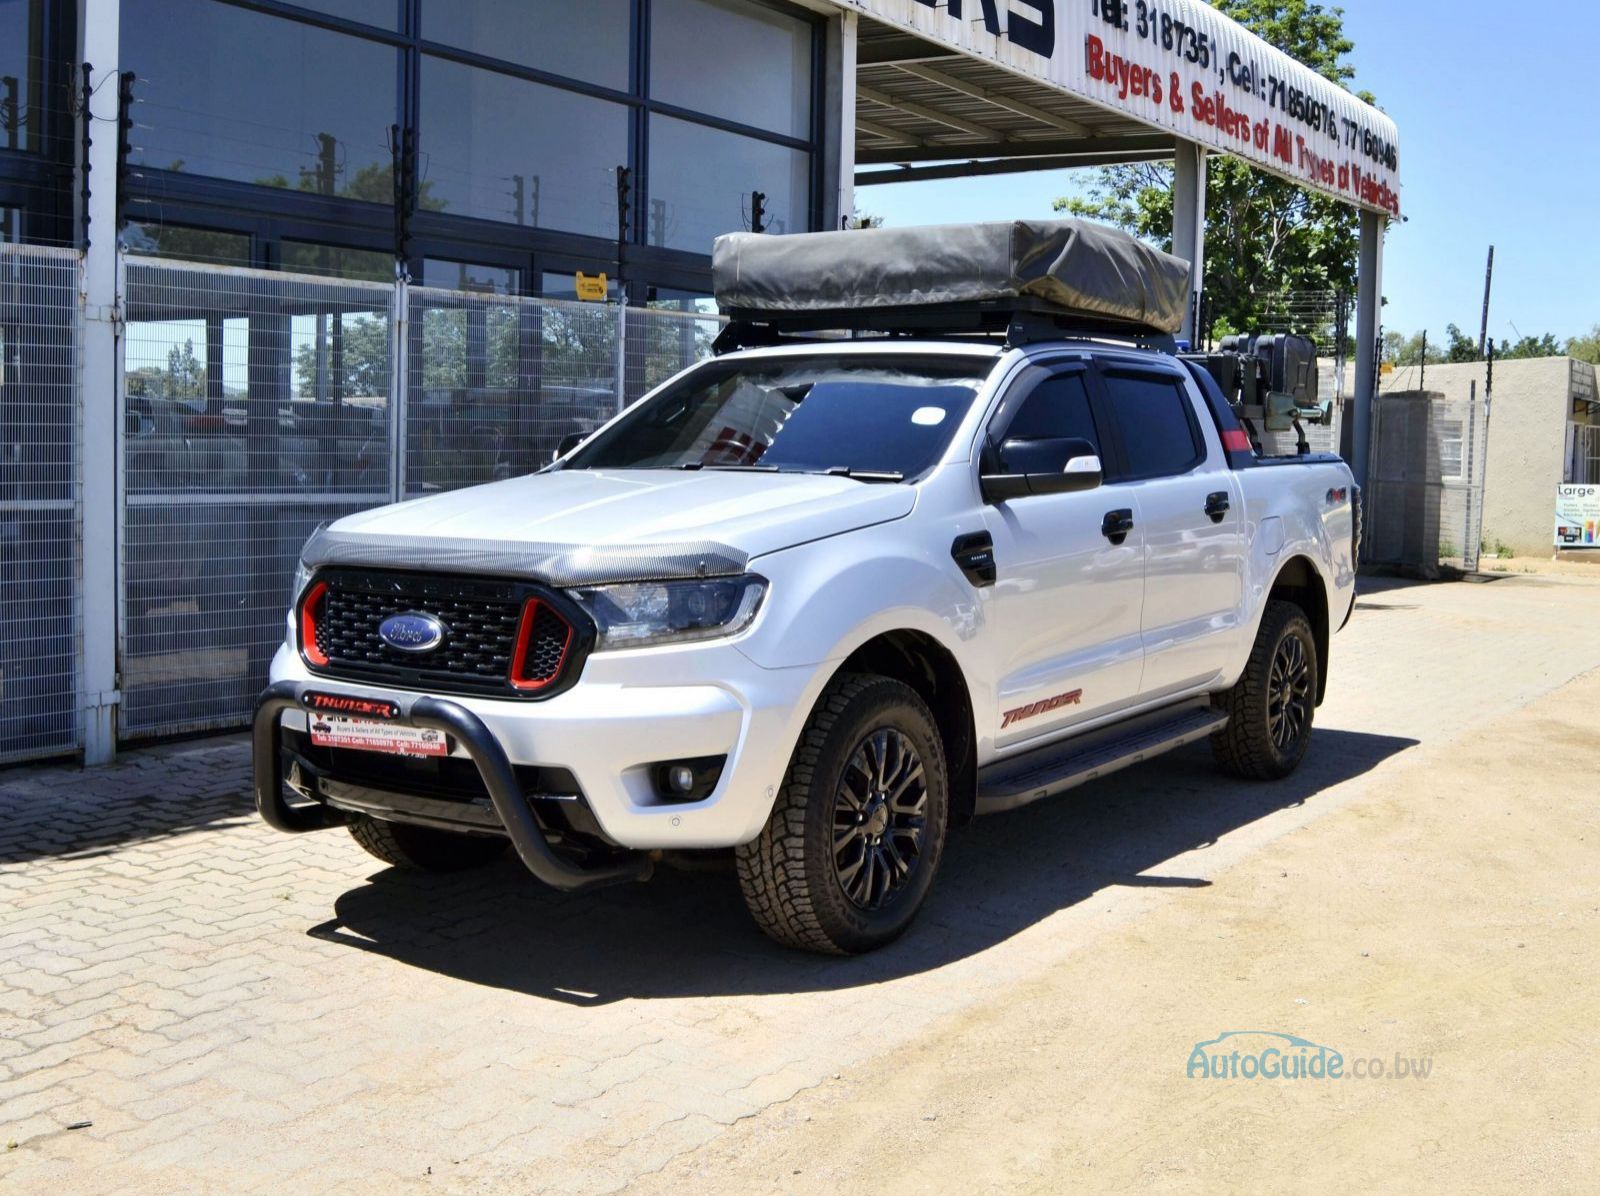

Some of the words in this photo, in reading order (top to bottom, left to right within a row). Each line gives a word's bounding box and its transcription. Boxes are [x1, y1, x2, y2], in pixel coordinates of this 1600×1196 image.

[1086, 33, 1163, 104] Buyers
[1169, 71, 1184, 114] &
[1191, 81, 1250, 143] Sellers
[1254, 117, 1270, 153] of
[1274, 123, 1293, 165] All
[1296, 134, 1335, 186] Types
[1338, 160, 1350, 191] of
[1351, 162, 1399, 215] Vehicles
[1558, 485, 1595, 497] Large
[1001, 687, 1083, 729] THUNDER
